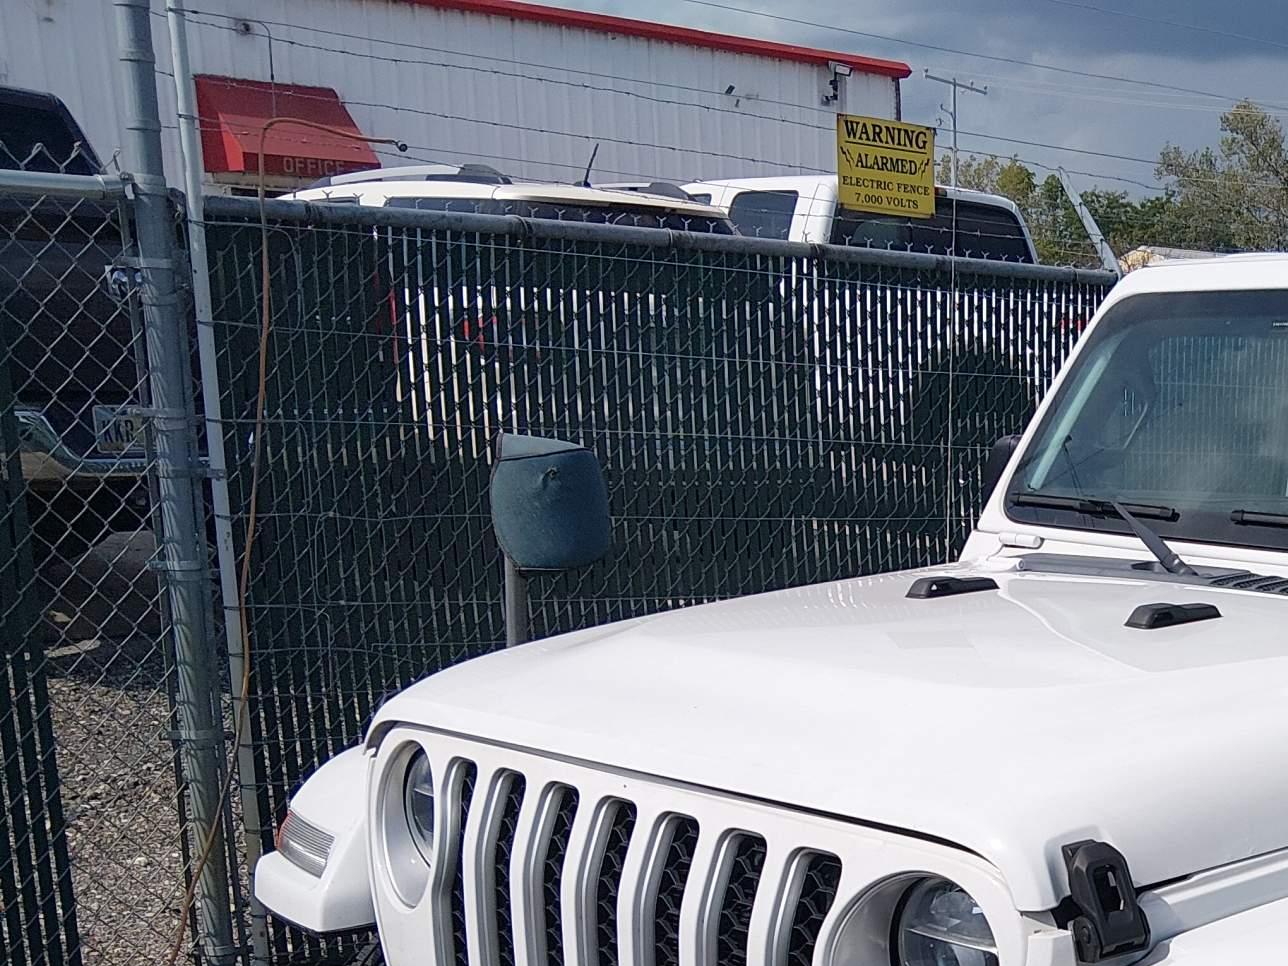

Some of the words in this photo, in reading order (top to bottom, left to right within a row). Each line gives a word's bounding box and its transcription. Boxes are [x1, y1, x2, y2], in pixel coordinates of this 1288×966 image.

[844, 119, 928, 150] WARNING
[283, 157, 345, 176] OFFICE
[855, 152, 918, 175] ALARMED
[842, 175, 894, 191] ELECTRIC
[896, 182, 930, 196] FENCE
[886, 196, 919, 209] VOLTS
